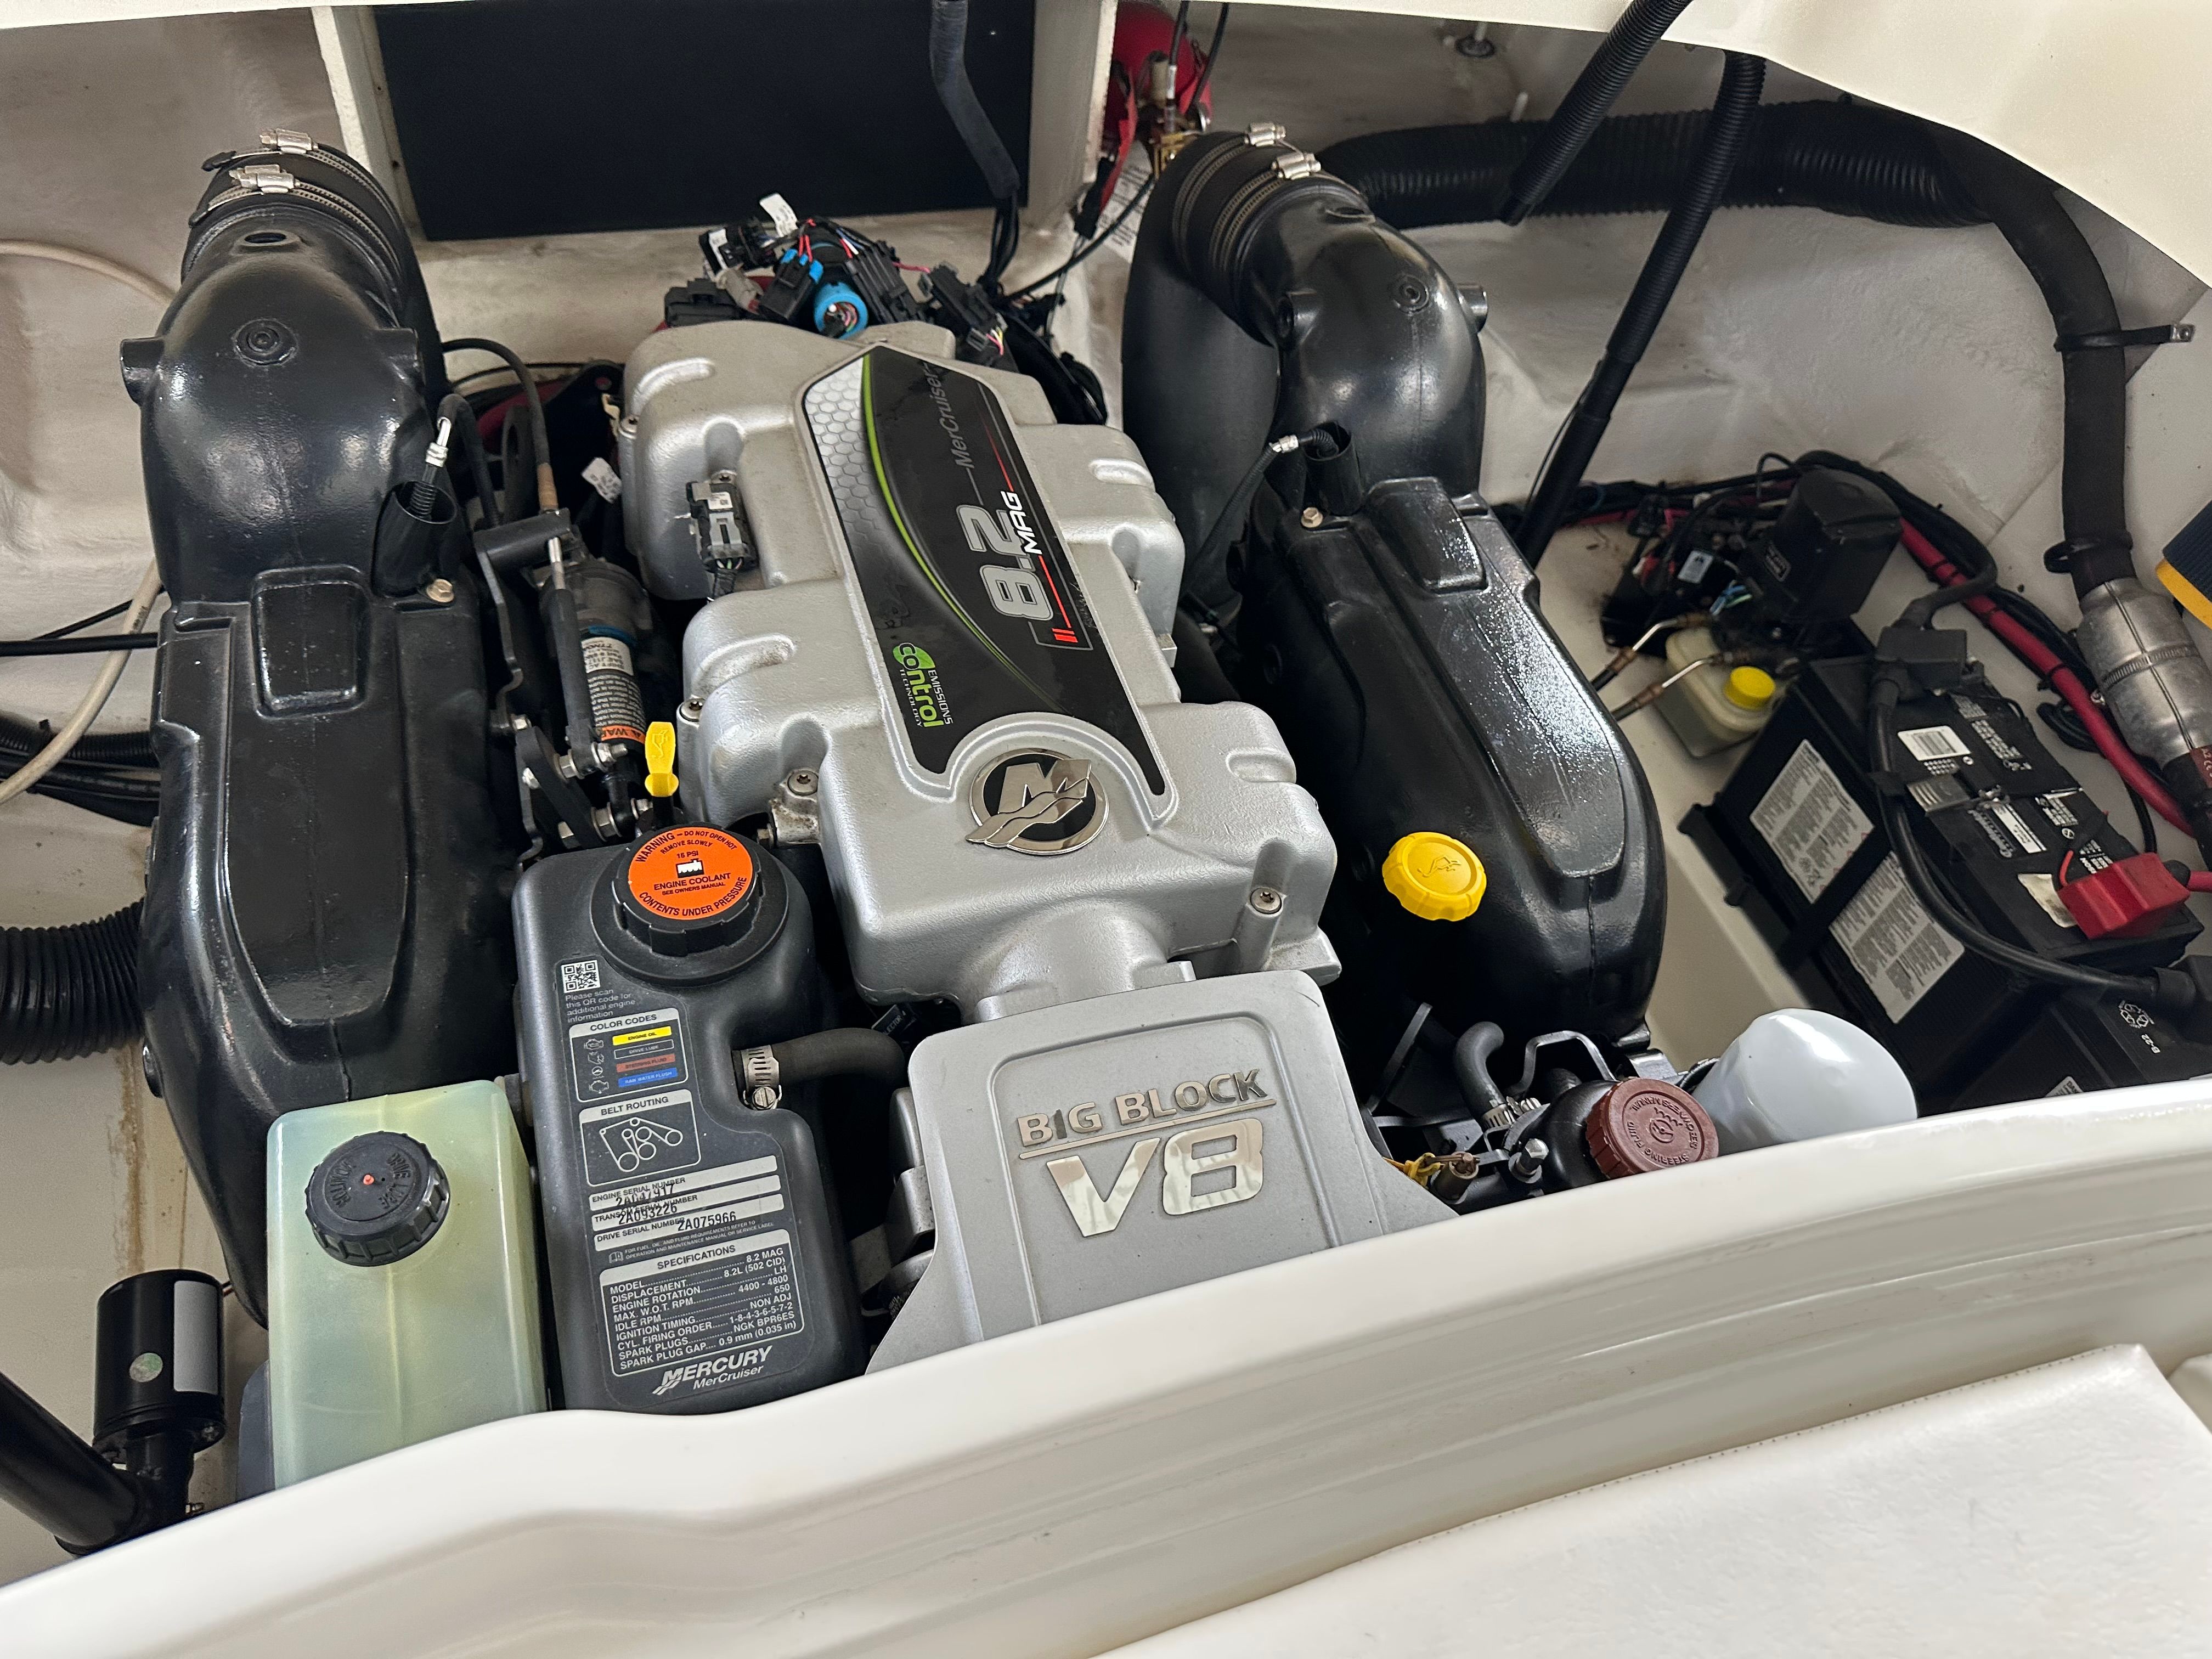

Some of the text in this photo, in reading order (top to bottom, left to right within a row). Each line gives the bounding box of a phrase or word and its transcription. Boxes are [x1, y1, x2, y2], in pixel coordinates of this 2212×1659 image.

[927, 371, 974, 469] MerCruiser
[1001, 490, 1042, 555] MAG
[956, 505, 1053, 621] 8.2
[899, 642, 944, 727] control
[900, 669, 923, 727] TECHNOLOGY
[928, 669, 953, 725] EMISSIONS
[635, 832, 675, 862] WARNING
[710, 833, 726, 843] OPEN
[725, 839, 737, 850] HOT
[660, 841, 685, 854] REMOVE
[640, 877, 747, 916] CONTENTS UNDER PRESSURE
[654, 872, 731, 890] ENGINE COOLANT
[565, 988, 614, 1001] Please scan
[566, 1000, 581, 1008] this
[582, 997, 596, 1006] QR
[597, 994, 618, 1003] code
[567, 1000, 635, 1015] additional engine
[567, 1010, 613, 1023] information
[590, 1014, 657, 1031] COLOR CODES
[601, 1095, 669, 1116] BELT ROUTING
[1017, 1068, 1269, 1147] BIG BLOCK
[1046, 1118, 1264, 1238] V8
[1645, 1148, 1689, 1165] STEERING
[591, 1177, 685, 1203] ENGINE SERIAL NUMBER
[664, 1194, 697, 1206] NUMBER
[596, 1216, 685, 1242] DRIVE SERIAL NUMBER
[677, 1208, 736, 1233] 2A075966
[610, 1246, 783, 1295] MODEL 8.2 MAG
[611, 1255, 786, 1304] DISPLACEMENT 8.2L (502 CID)
[657, 1244, 736, 1269] SPECIFICATIONS
[612, 1265, 787, 1313] ENGINE ROTATION LH
[613, 1310, 638, 1322] MAX.
[672, 1296, 693, 1308] RPM
[737, 1281, 760, 1293] 4400
[766, 1273, 788, 1286] 4800
[614, 1283, 790, 1331] IDLE RPM 650
[616, 1292, 792, 1341] IGNITION TIMING NON ADJ
[617, 1301, 793, 1350] CYL. FIRING ORDER 1-8-4-3-6-5-7-2
[618, 1310, 795, 1360] SPARK PLUGS NGK BPR6ES
[619, 1319, 797, 1369] SPARK PLUG GAP 0.9 mm (0.035 in)
[656, 1345, 773, 1391] MERCURY
[691, 1363, 764, 1389] MerCruiser
